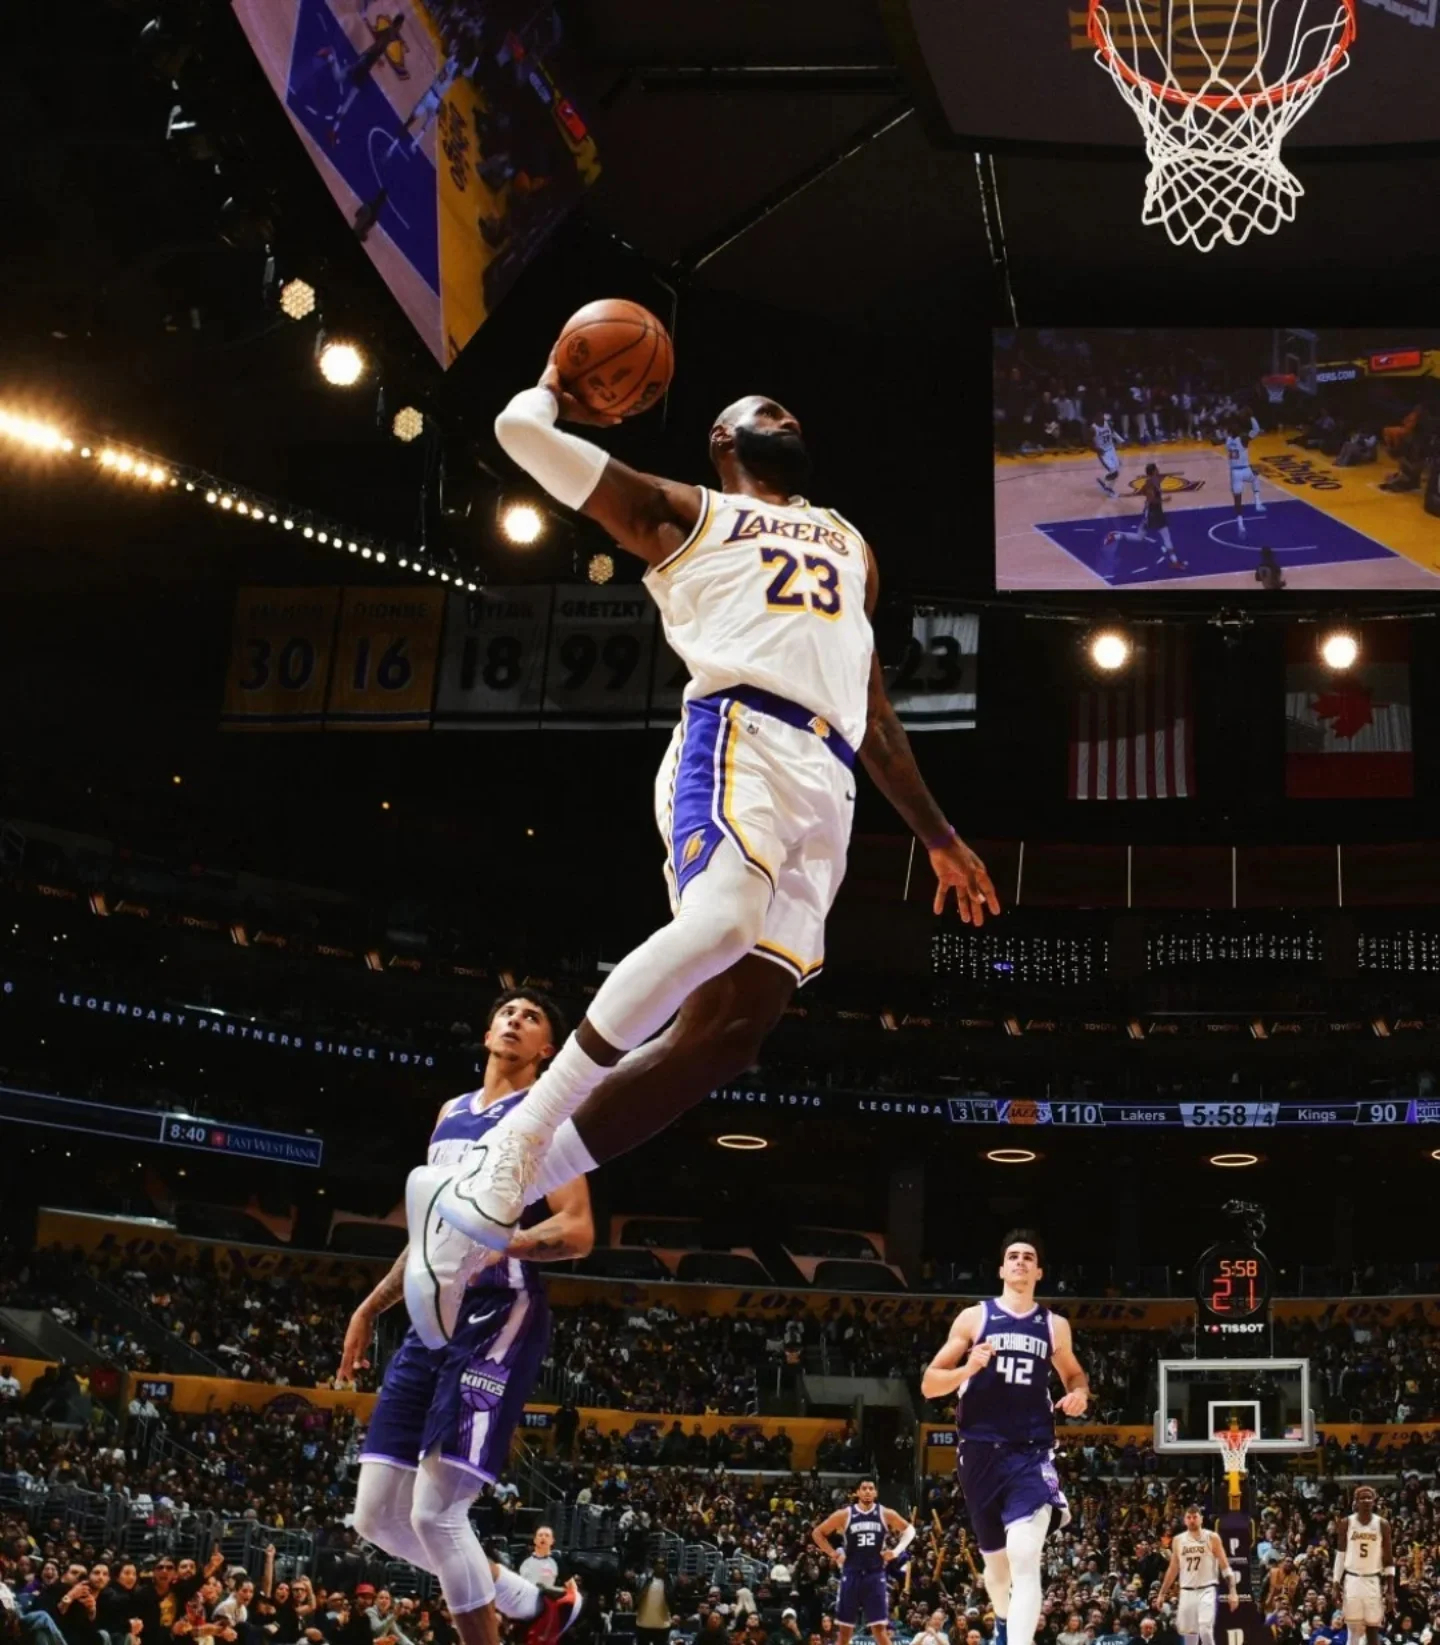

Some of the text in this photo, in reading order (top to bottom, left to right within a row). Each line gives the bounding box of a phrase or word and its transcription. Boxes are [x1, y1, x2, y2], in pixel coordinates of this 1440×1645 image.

[723, 509, 849, 556] LAKERS
[760, 547, 842, 621] 23
[561, 600, 646, 617] GRETZKY
[240, 637, 315, 690] 30
[353, 634, 413, 690] 16
[460, 636, 523, 690] 18
[559, 634, 641, 690] 99
[59, 992, 434, 1067] LEGENDARY PARTNERS SINCE 1976
[710, 1090, 821, 1107] SINCE 1976
[859, 1101, 942, 1115] LEGENDA
[959, 1108, 968, 1120] 3
[982, 1109, 990, 1121] 1
[1057, 1104, 1097, 1123] 110
[1120, 1109, 1166, 1121] Lakers
[1192, 1105, 1247, 1126] 5:58
[1297, 1109, 1337, 1123] Kings
[1370, 1104, 1397, 1122] 90
[1262, 1111, 1274, 1125] 4
[170, 1124, 205, 1142] 8:40
[1219, 1260, 1257, 1278] 5:58
[1212, 1279, 1255, 1310] 21
[1219, 1323, 1264, 1334] TISSOT
[996, 1356, 1034, 1385] 42
[461, 1371, 507, 1398] KINGS
[525, 1414, 547, 1427] 115
[932, 1432, 953, 1444] 115
[857, 1533, 876, 1547] 32
[1360, 1543, 1369, 1557] 5
[1186, 1557, 1201, 1571] 77
